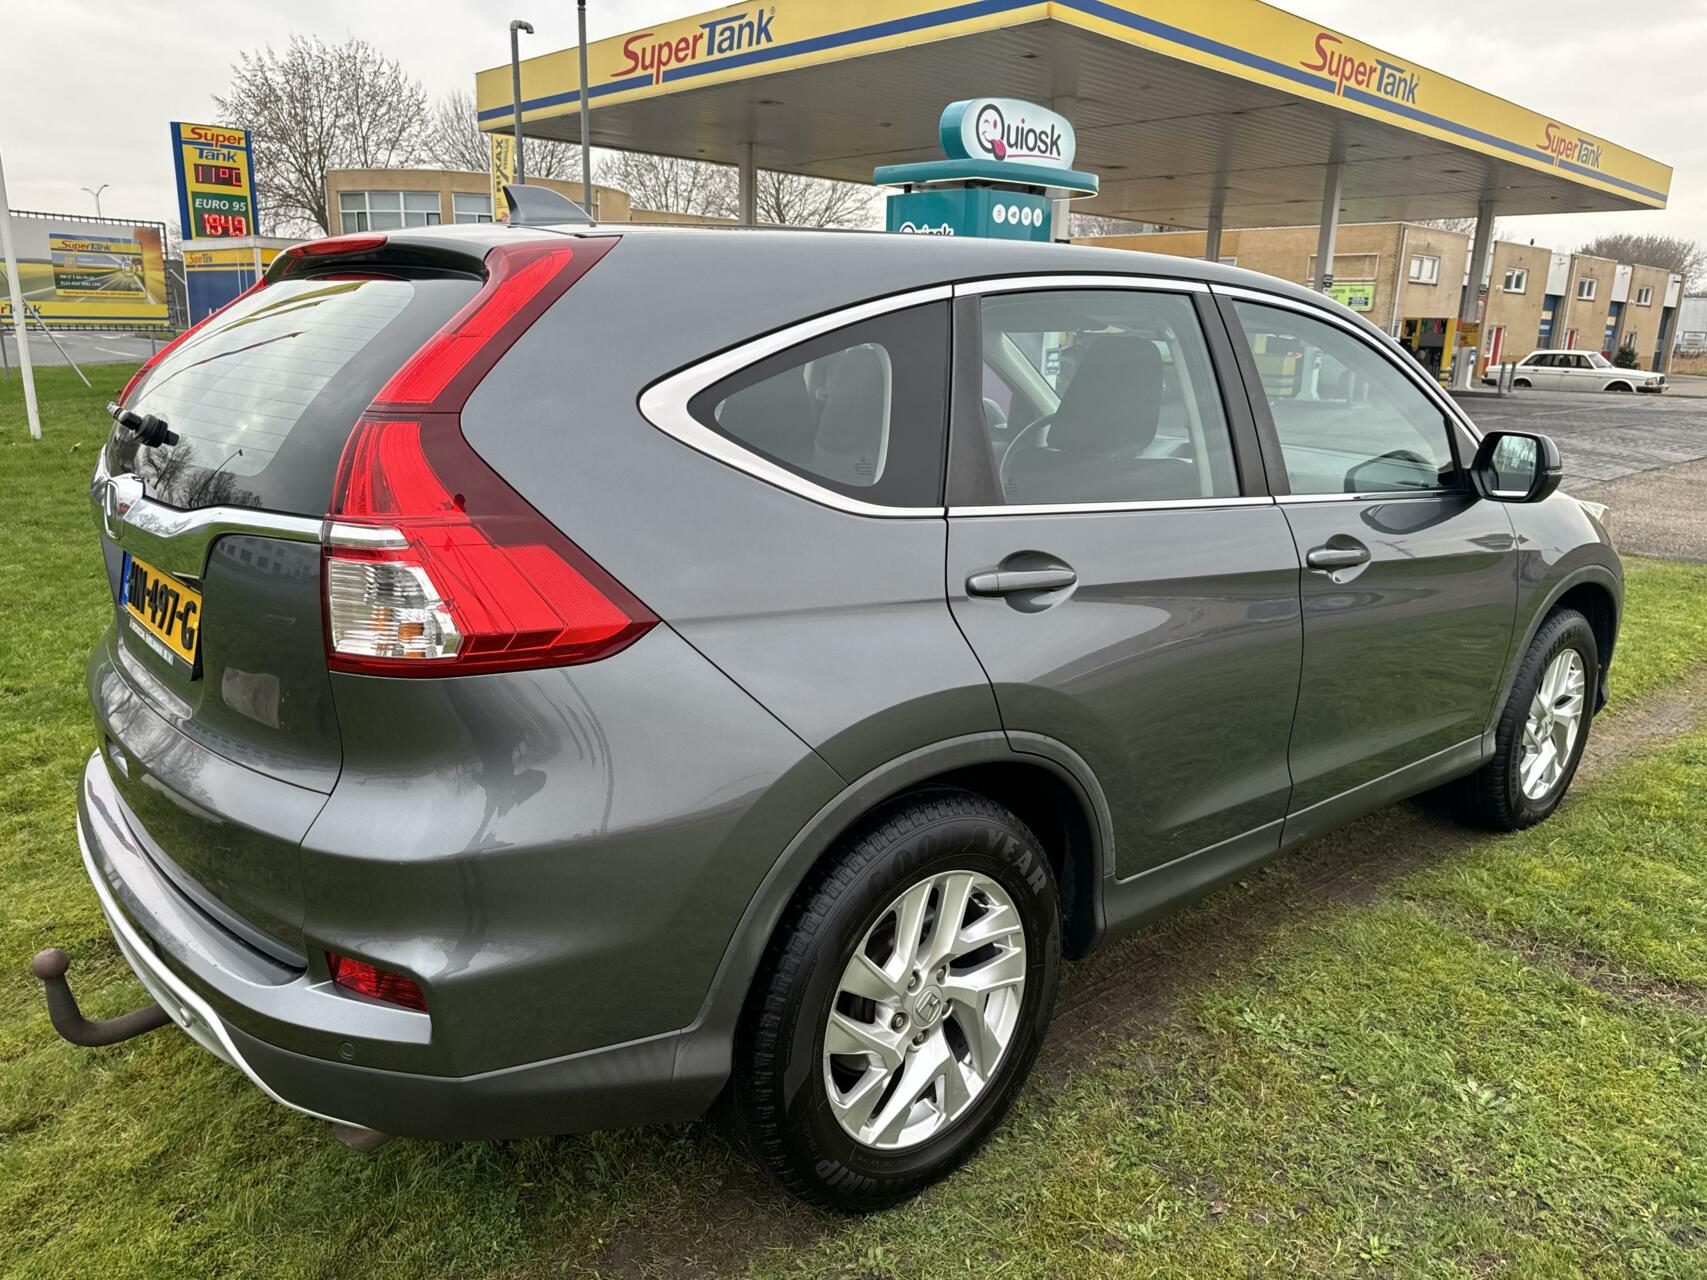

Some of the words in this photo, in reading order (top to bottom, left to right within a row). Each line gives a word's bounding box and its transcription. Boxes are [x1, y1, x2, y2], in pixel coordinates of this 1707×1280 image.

[610, 8, 775, 85] SuperTank
[1299, 32, 1418, 105] SuperTank
[182, 127, 244, 149] Super
[975, 103, 1062, 161] Quiosk
[1536, 122, 1602, 168] SuperTank
[193, 146, 237, 163] Tank
[195, 198, 229, 210] EURO
[232, 202, 247, 212] 95
[60, 240, 111, 251] SuperTank
